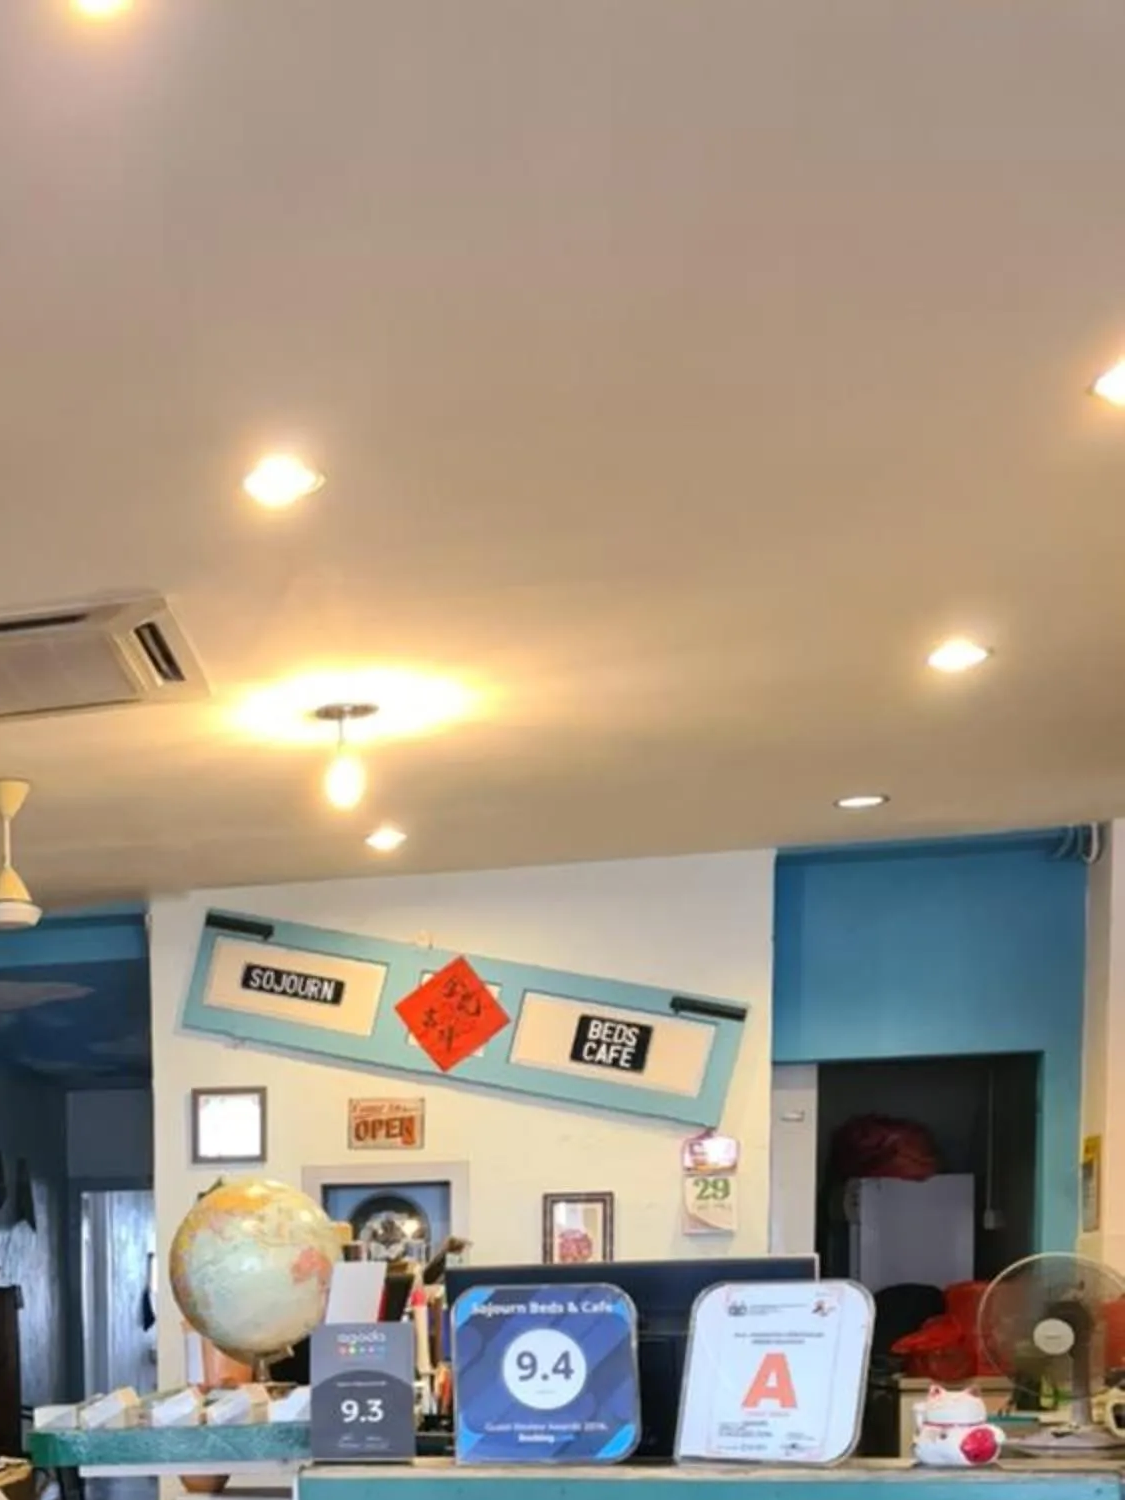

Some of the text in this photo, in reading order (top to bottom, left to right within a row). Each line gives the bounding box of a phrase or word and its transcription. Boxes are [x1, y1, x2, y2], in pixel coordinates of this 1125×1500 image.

[249, 967, 335, 1001] SOJOURN
[587, 1019, 640, 1047] BEDS
[582, 1040, 635, 1068] CAFE
[354, 1115, 416, 1146] OPEN
[692, 1178, 731, 1201] 29
[529, 1301, 565, 1314] Beds
[516, 1350, 575, 1382] 9.4
[741, 1351, 798, 1410] A
[340, 1398, 385, 1423] 9.3
